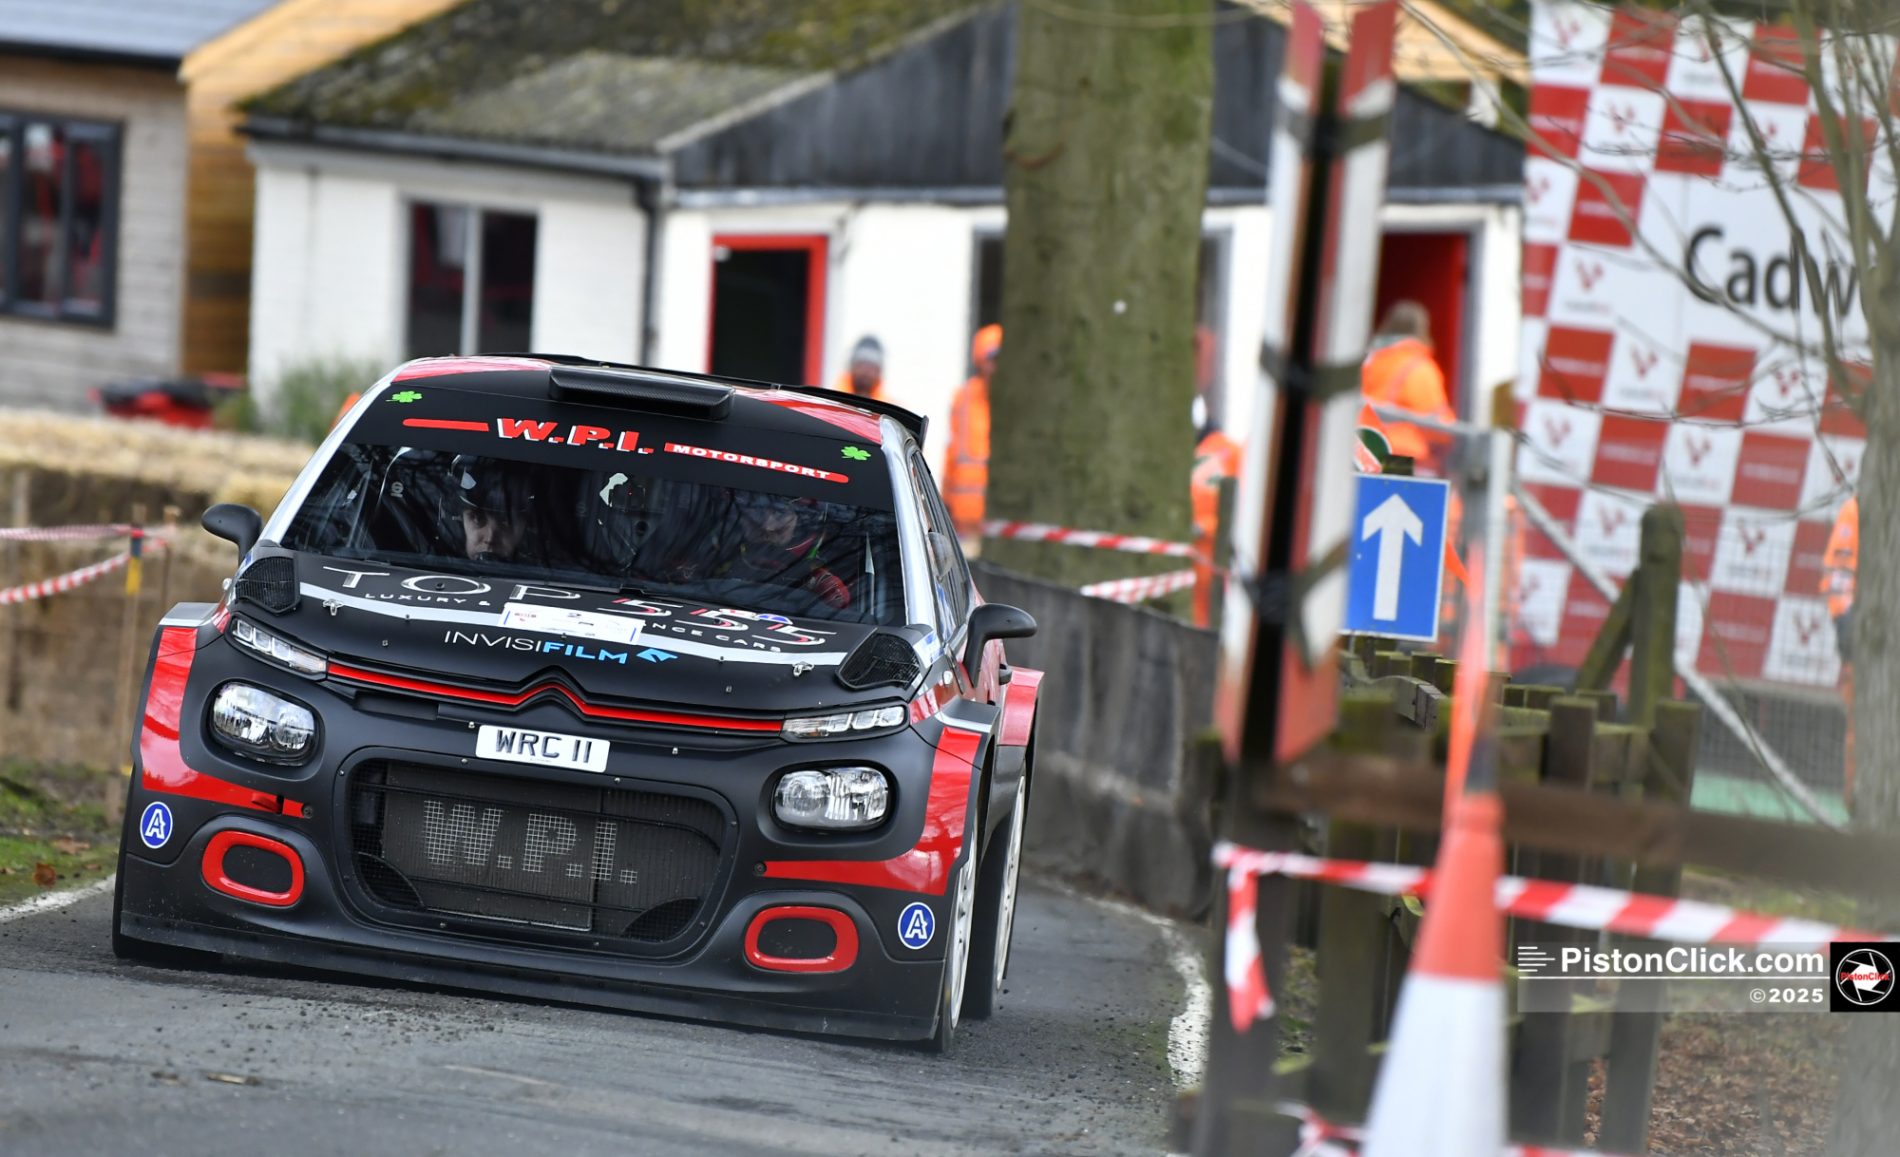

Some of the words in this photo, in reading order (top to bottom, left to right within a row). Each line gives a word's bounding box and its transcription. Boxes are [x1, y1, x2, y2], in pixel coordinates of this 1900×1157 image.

[496, 417, 655, 455] W.P.I.
[672, 443, 831, 480] MOTORSPORT
[322, 565, 582, 601] TOP
[596, 597, 838, 647] 555
[364, 592, 467, 605] LUXURY
[477, 599, 491, 607] &
[444, 629, 628, 665] INVISIFILM
[715, 633, 782, 653] CARS
[495, 729, 563, 759] WRC
[422, 799, 639, 885] W.P.I.
